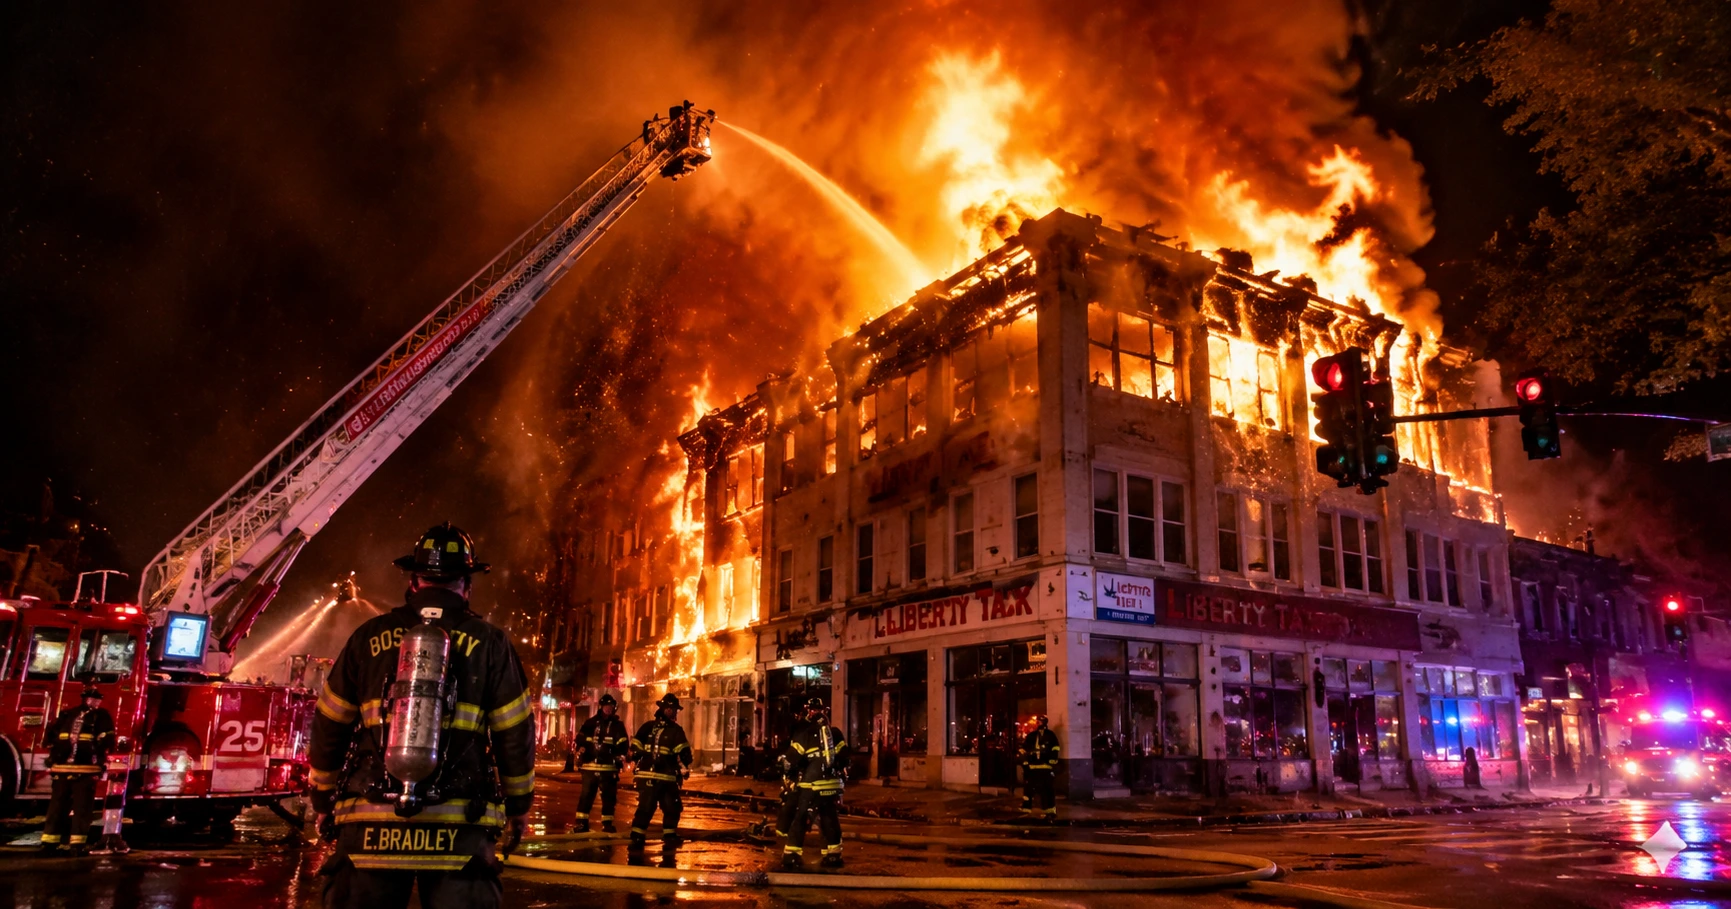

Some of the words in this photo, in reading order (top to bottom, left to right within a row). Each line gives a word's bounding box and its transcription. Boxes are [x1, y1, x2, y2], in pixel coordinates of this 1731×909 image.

[1166, 588, 1266, 628] LIBERTY
[369, 627, 410, 657] BOS
[219, 720, 266, 752] 25
[363, 827, 459, 852] E.BRADLEY
